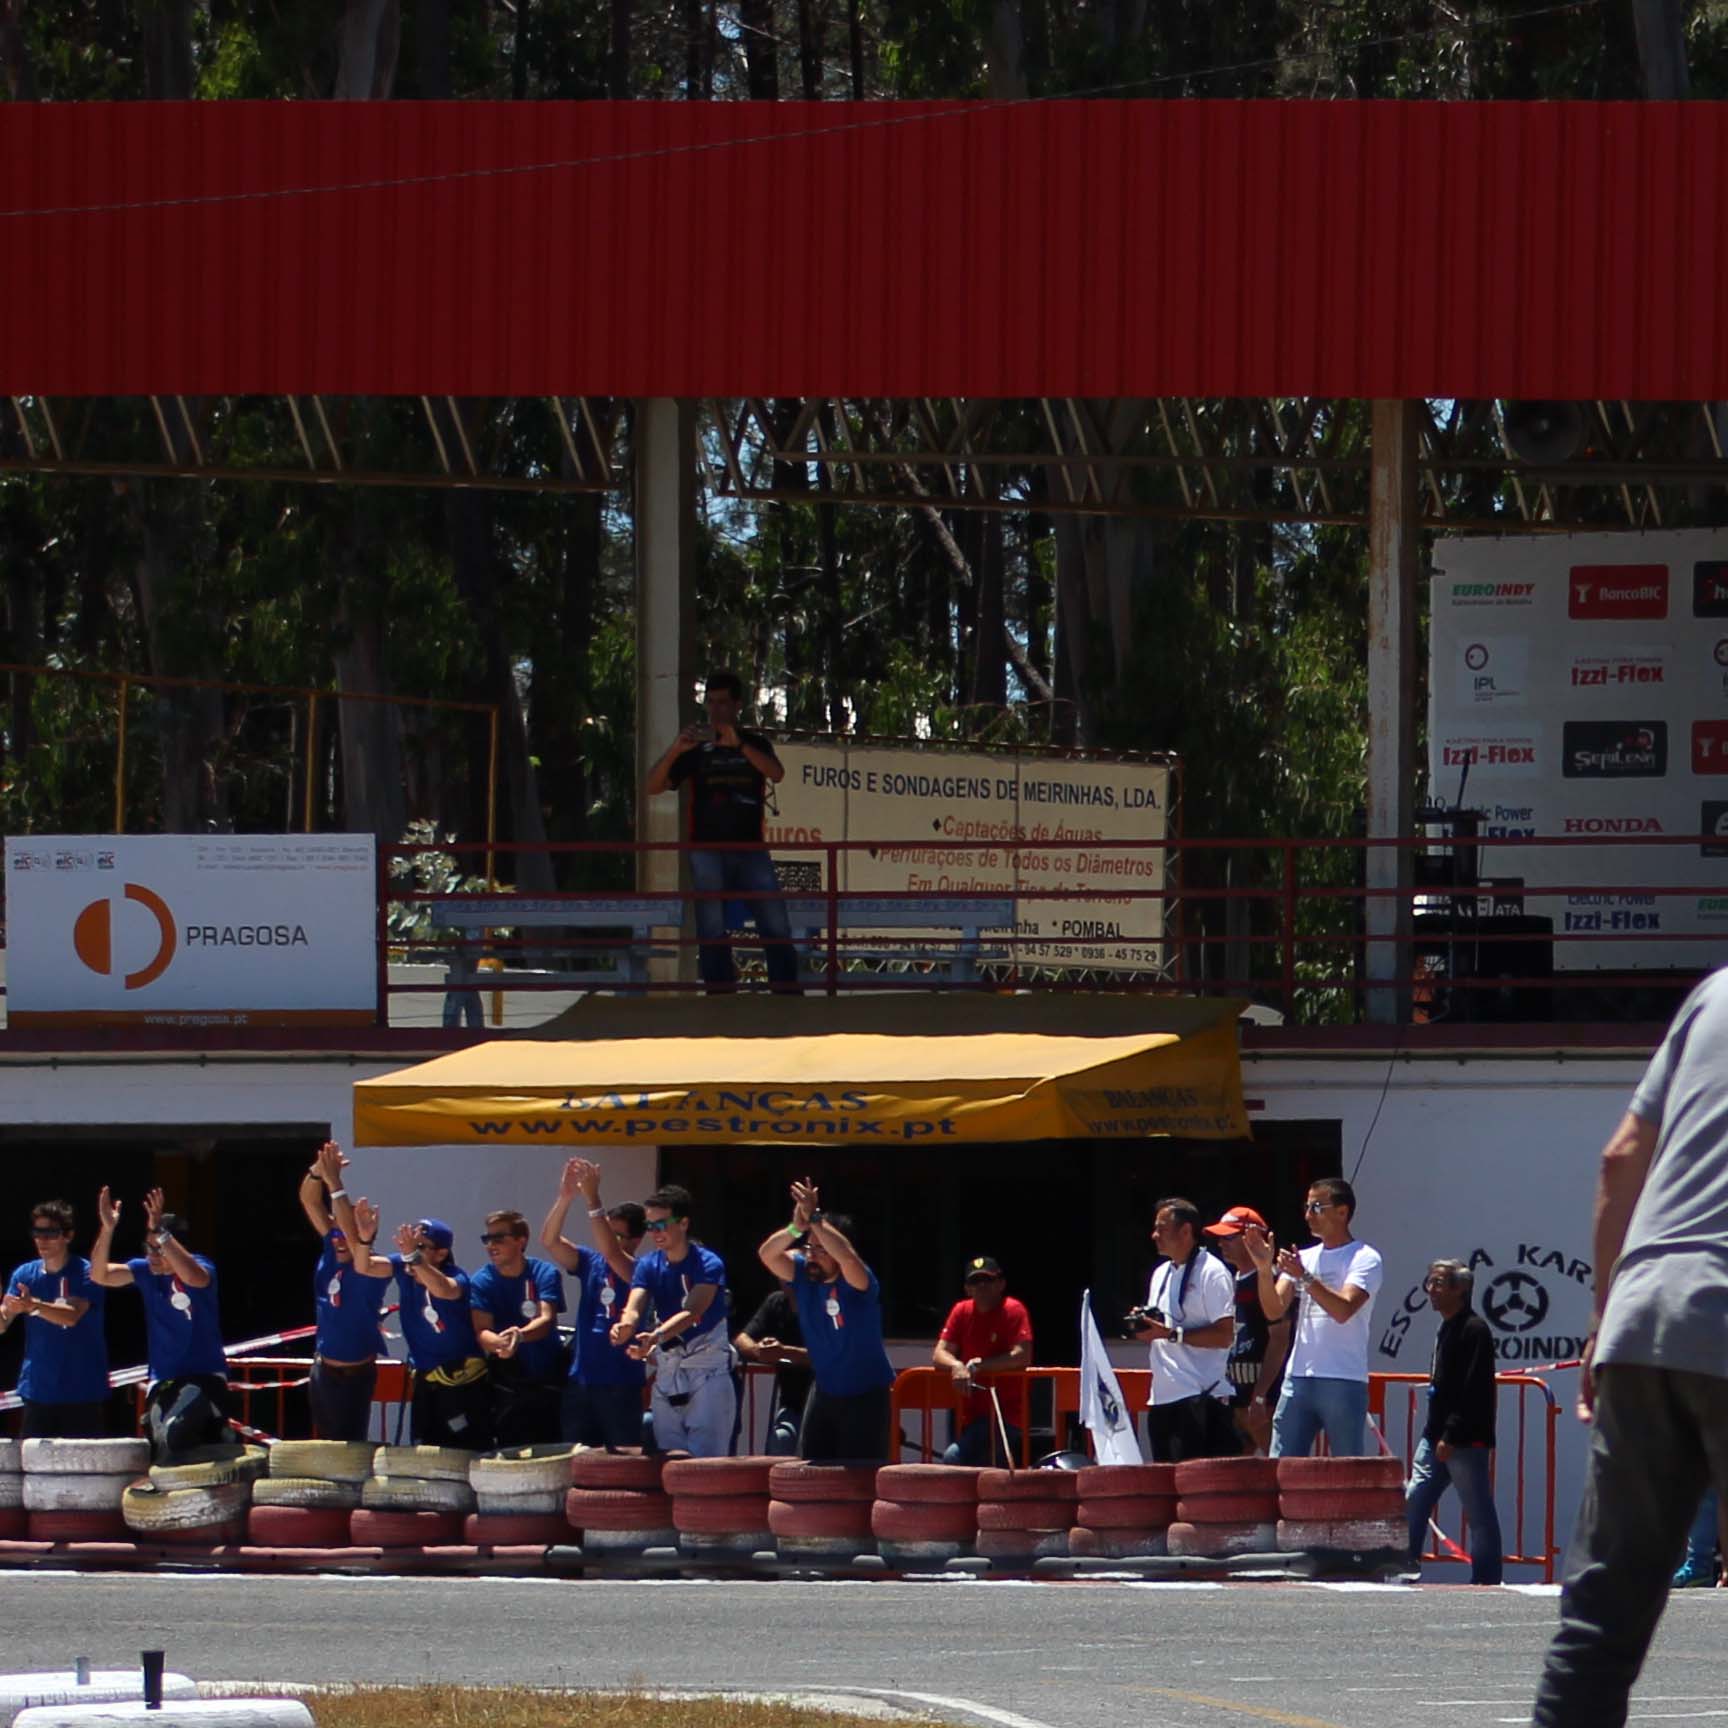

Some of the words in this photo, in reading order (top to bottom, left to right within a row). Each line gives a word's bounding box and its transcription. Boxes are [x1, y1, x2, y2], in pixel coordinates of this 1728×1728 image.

[1451, 582, 1536, 597] EUROINDY
[803, 764, 862, 791] FUROS
[867, 772, 878, 793] E
[882, 774, 991, 800] SONDAGENS
[997, 779, 1018, 799] DE
[1024, 781, 1119, 811] MEIRINHAS,
[1123, 787, 1161, 810] LDA.
[943, 815, 1026, 841] Captações
[1032, 823, 1049, 840] de
[1563, 816, 1665, 834] HONDA
[978, 849, 997, 868] de
[1005, 850, 1049, 871] Todos
[1054, 856, 1071, 873] os
[1076, 852, 1153, 876] Diâmetros
[186, 925, 309, 947] PRAGOSA
[1061, 919, 1125, 939] POMBAL
[468, 1114, 958, 1137] www.pestronix.pt
